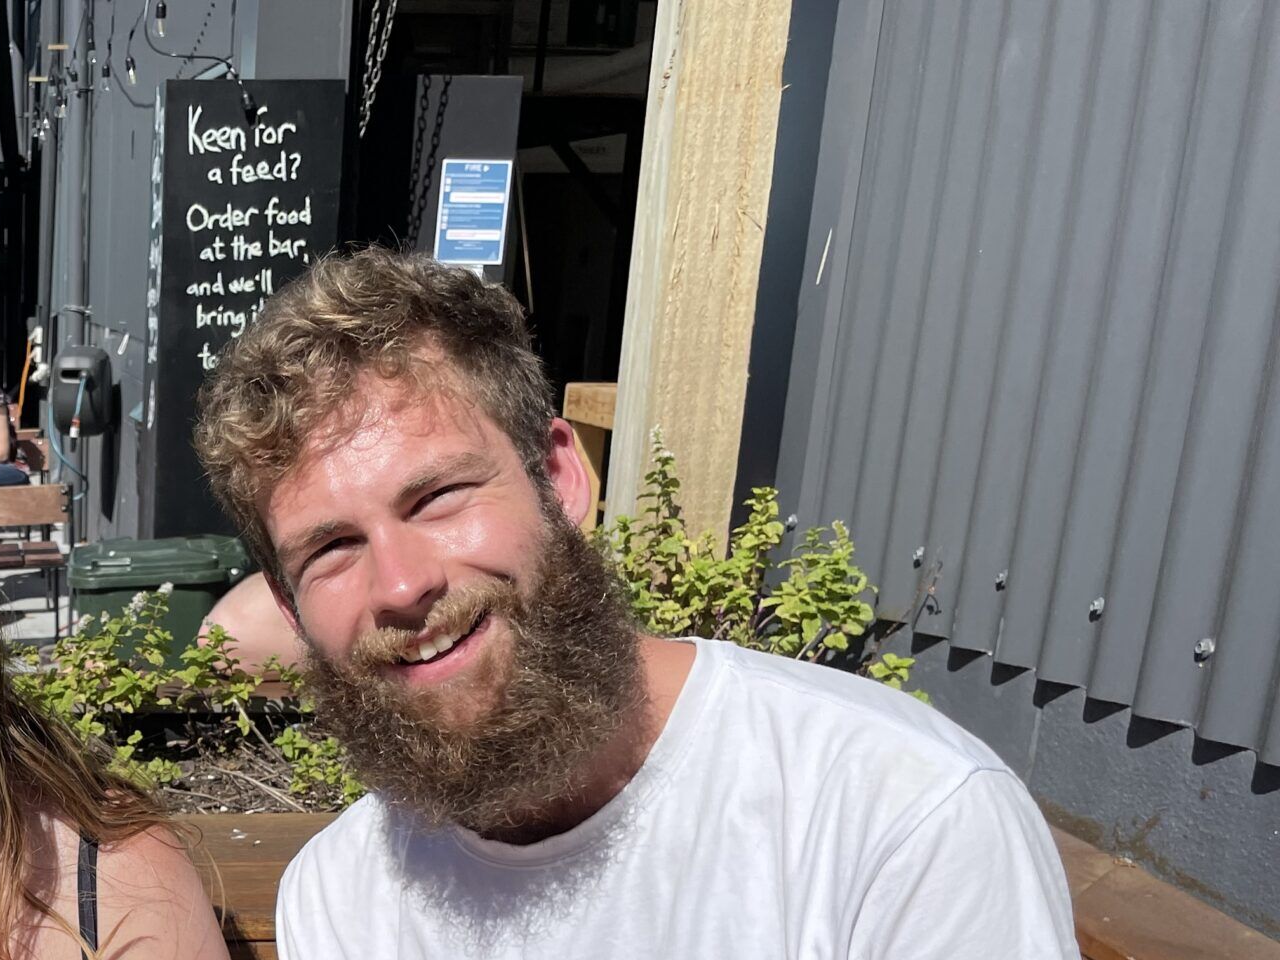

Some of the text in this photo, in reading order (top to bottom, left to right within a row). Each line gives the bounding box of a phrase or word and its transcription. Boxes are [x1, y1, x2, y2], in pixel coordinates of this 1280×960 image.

[188, 104, 296, 155] Keen for
[207, 150, 301, 185] a feed?
[186, 196, 312, 232] Order food
[199, 229, 309, 264] at the bar,
[186, 269, 273, 297] and we'll
[196, 303, 246, 338] bring
